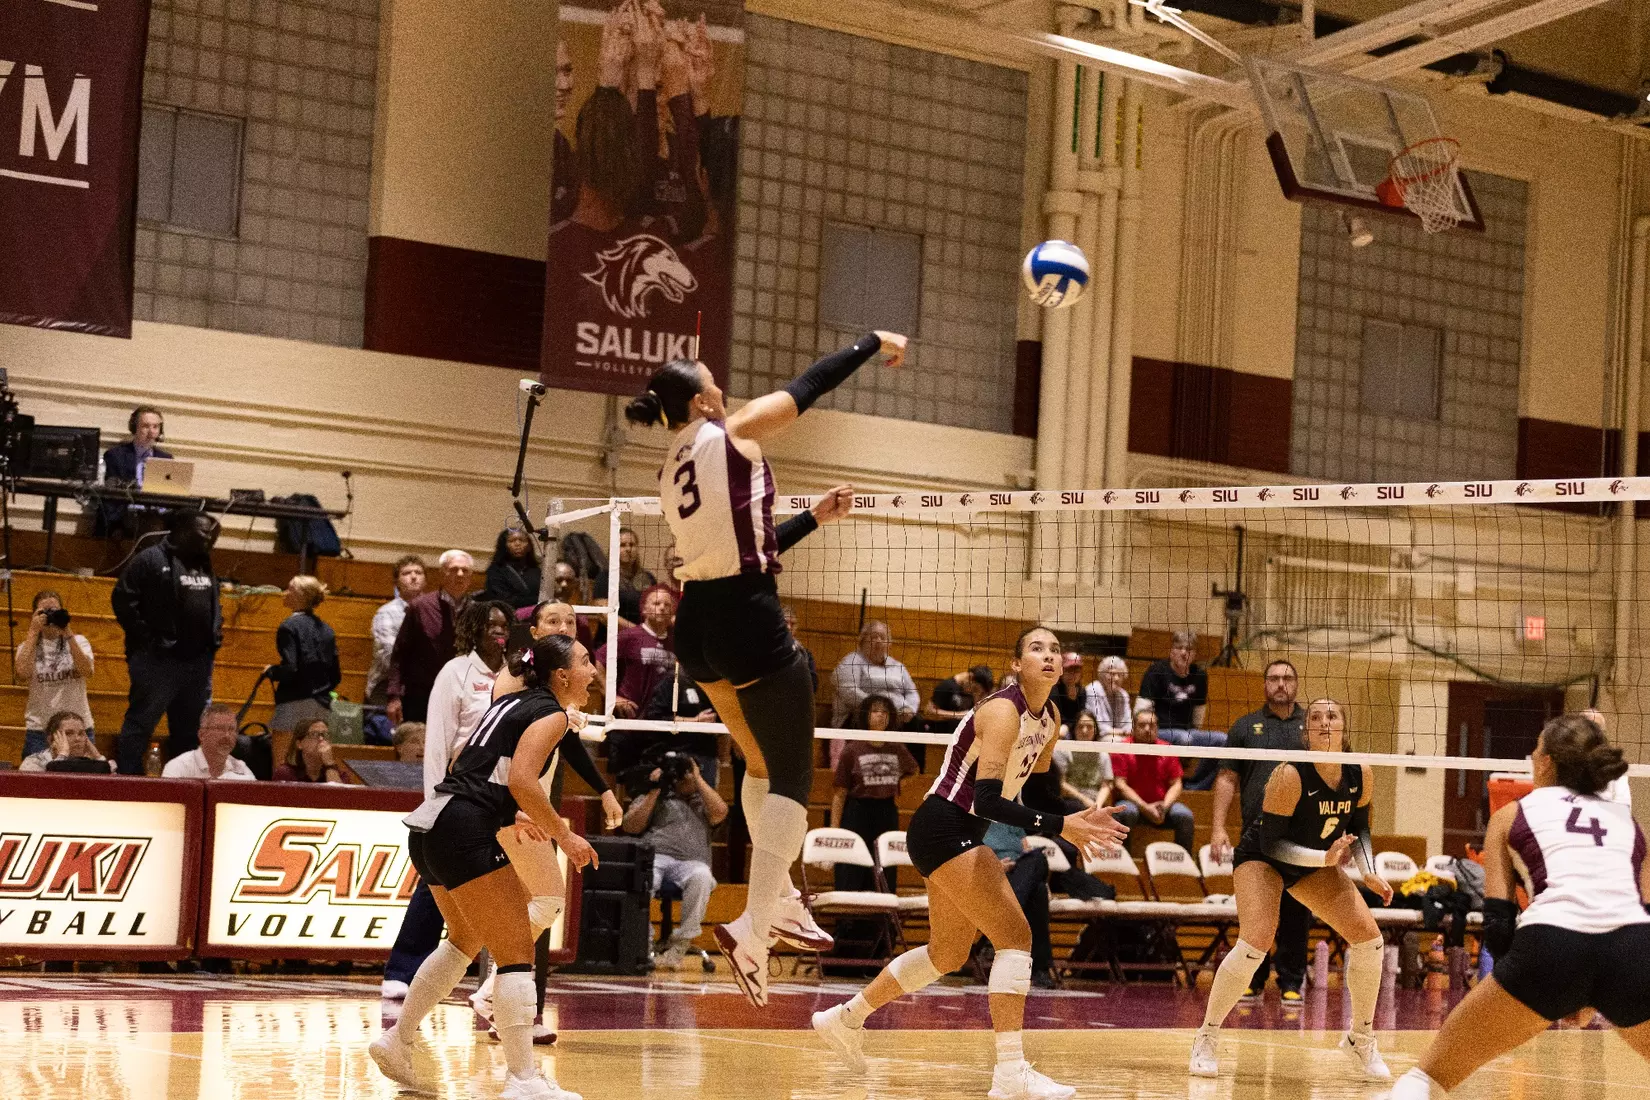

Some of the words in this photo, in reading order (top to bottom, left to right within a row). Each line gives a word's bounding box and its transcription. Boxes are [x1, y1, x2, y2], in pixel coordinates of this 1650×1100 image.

[0, 60, 91, 166] M
[576, 322, 698, 363] SALUKI
[673, 459, 702, 520] 3
[854, 496, 875, 508] SIU
[921, 495, 943, 507] SIU
[989, 493, 1012, 506] SIU
[1061, 492, 1084, 505] SIU
[1135, 491, 1160, 504] SIU
[1212, 489, 1238, 503] SIU
[1293, 488, 1319, 501] SIU
[1377, 486, 1404, 499] SIU
[1464, 484, 1493, 498] SIU
[1555, 481, 1585, 496] SIU
[1318, 800, 1352, 816] VALPO
[1565, 806, 1608, 847] 4
[0, 909, 148, 936] BALL
[227, 912, 449, 940] VOLLE
